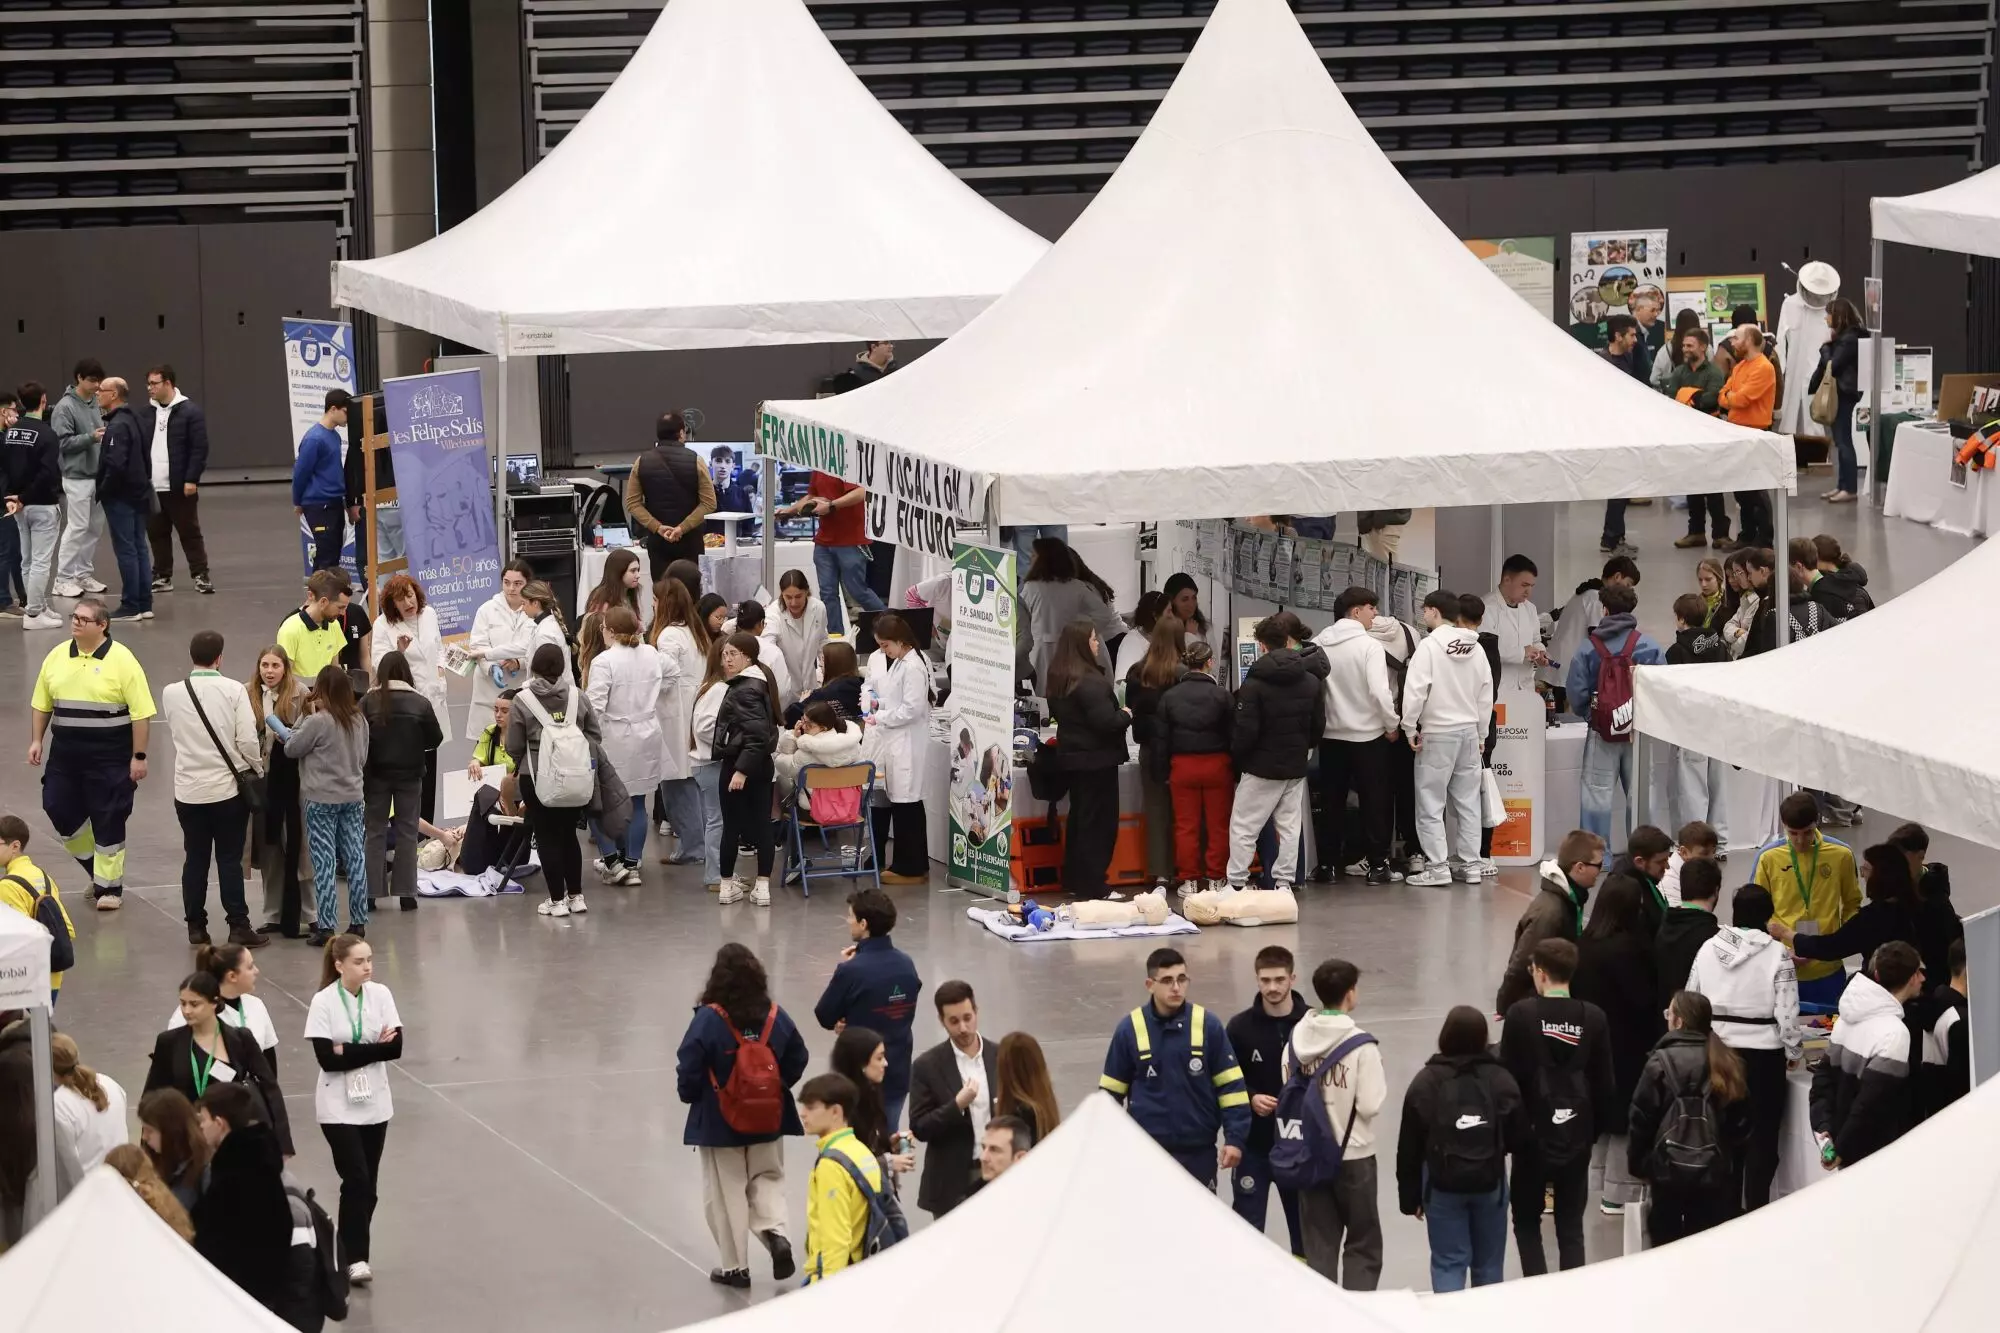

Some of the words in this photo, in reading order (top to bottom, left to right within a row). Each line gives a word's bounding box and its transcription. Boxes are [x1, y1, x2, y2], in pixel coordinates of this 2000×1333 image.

[301, 370, 337, 381] ELECTRÓNICA
[409, 422, 450, 445] Felipe
[450, 416, 484, 437] Solís
[856, 439, 875, 488] TU
[864, 490, 887, 538] TU
[418, 567, 438, 581] más
[439, 562, 451, 578] de
[452, 555, 473, 576] 50
[475, 558, 499, 573] años
[428, 577, 465, 597] creando
[466, 574, 492, 591] futuro
[959, 605, 968, 617] F.P.
[969, 608, 994, 623] SANIDAD
[967, 848, 975, 859] IES
[982, 853, 1010, 870] FUENSANTA
